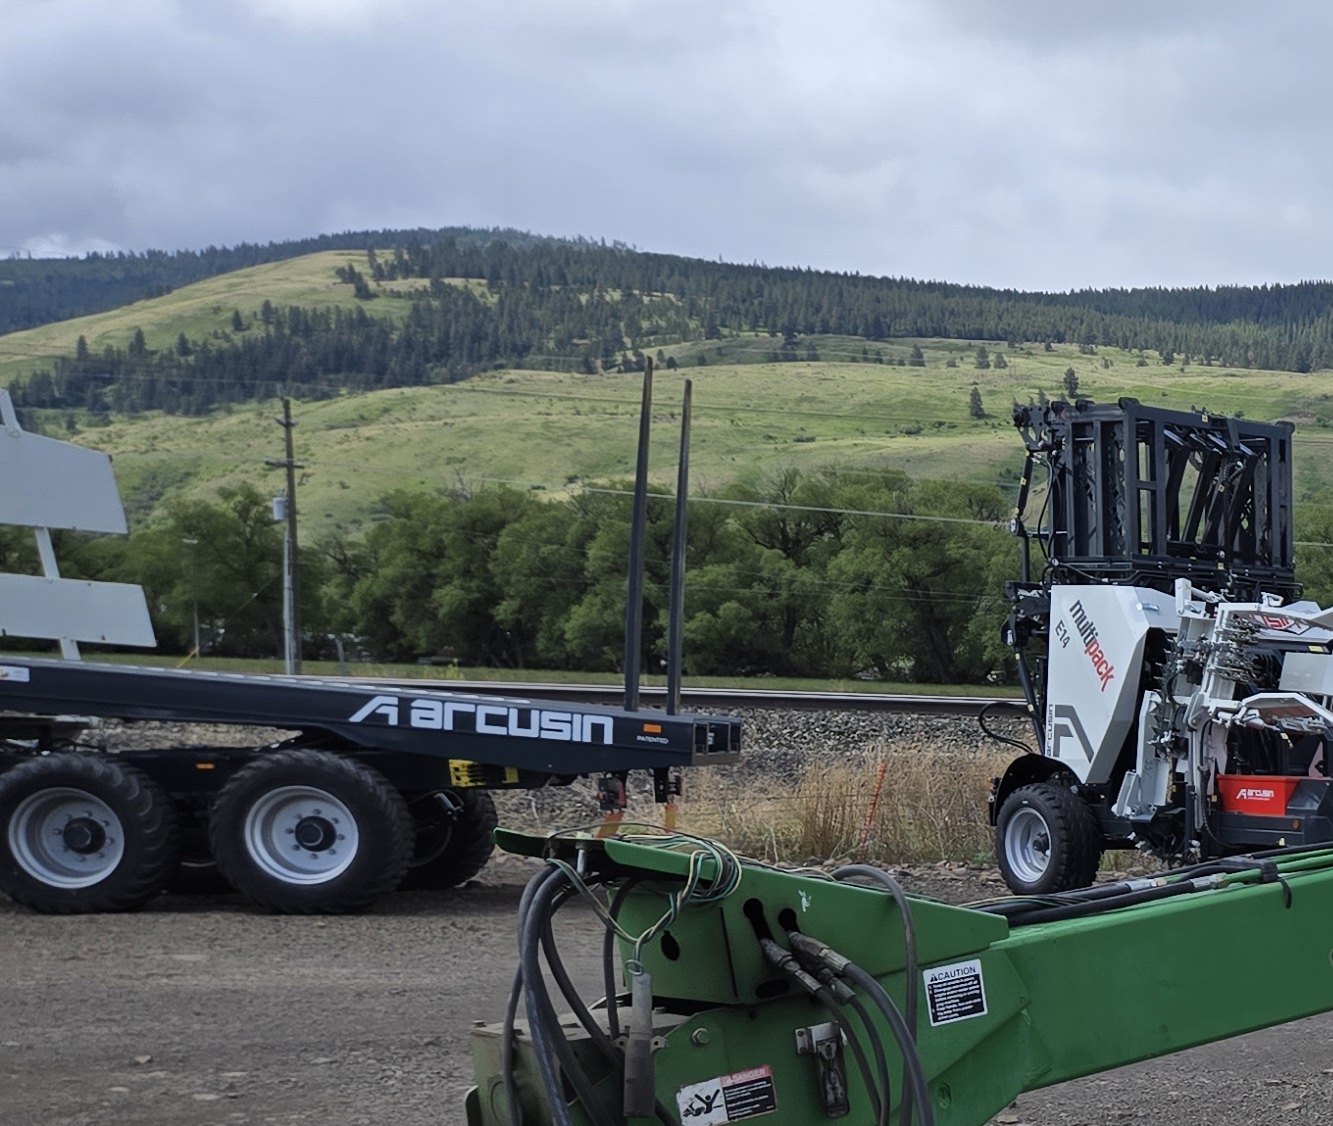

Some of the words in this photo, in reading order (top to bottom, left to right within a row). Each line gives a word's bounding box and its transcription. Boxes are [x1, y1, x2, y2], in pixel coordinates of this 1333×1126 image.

[1055, 619, 1071, 649] E14
[1069, 599, 1114, 692] multipack
[410, 699, 614, 745] arcusin
[937, 966, 976, 981] CAUTION
